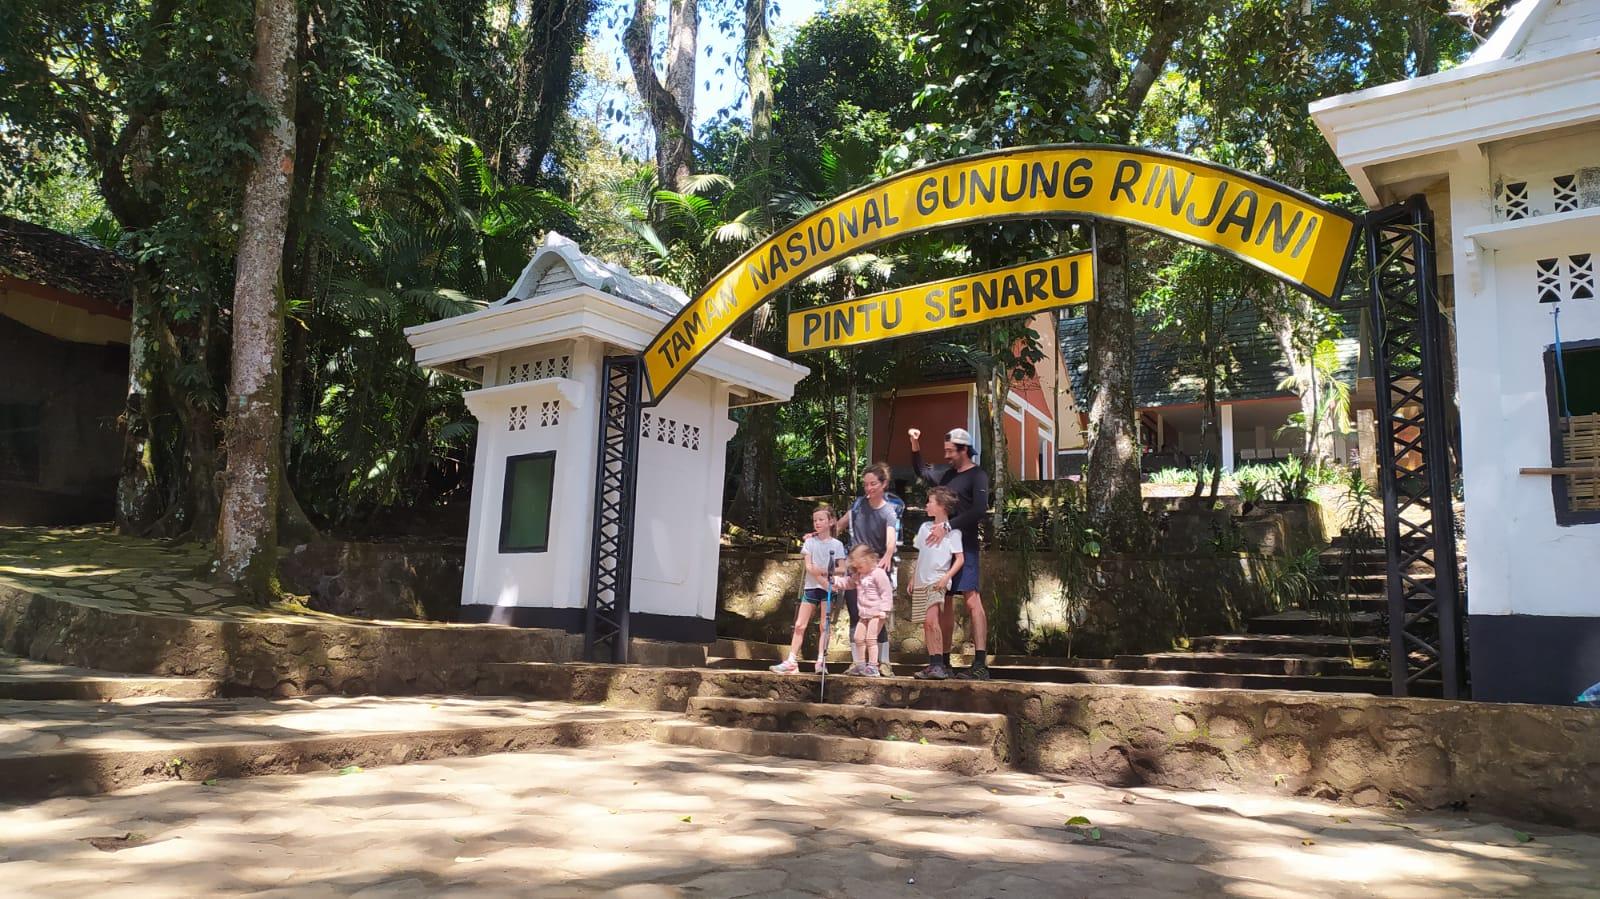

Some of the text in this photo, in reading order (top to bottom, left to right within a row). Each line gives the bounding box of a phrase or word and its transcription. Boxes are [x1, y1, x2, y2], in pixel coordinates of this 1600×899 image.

[658, 158, 1318, 369] TAMAN NASIONAL GUNUNG RINJANI
[803, 261, 1079, 346] PINTU SENARU
